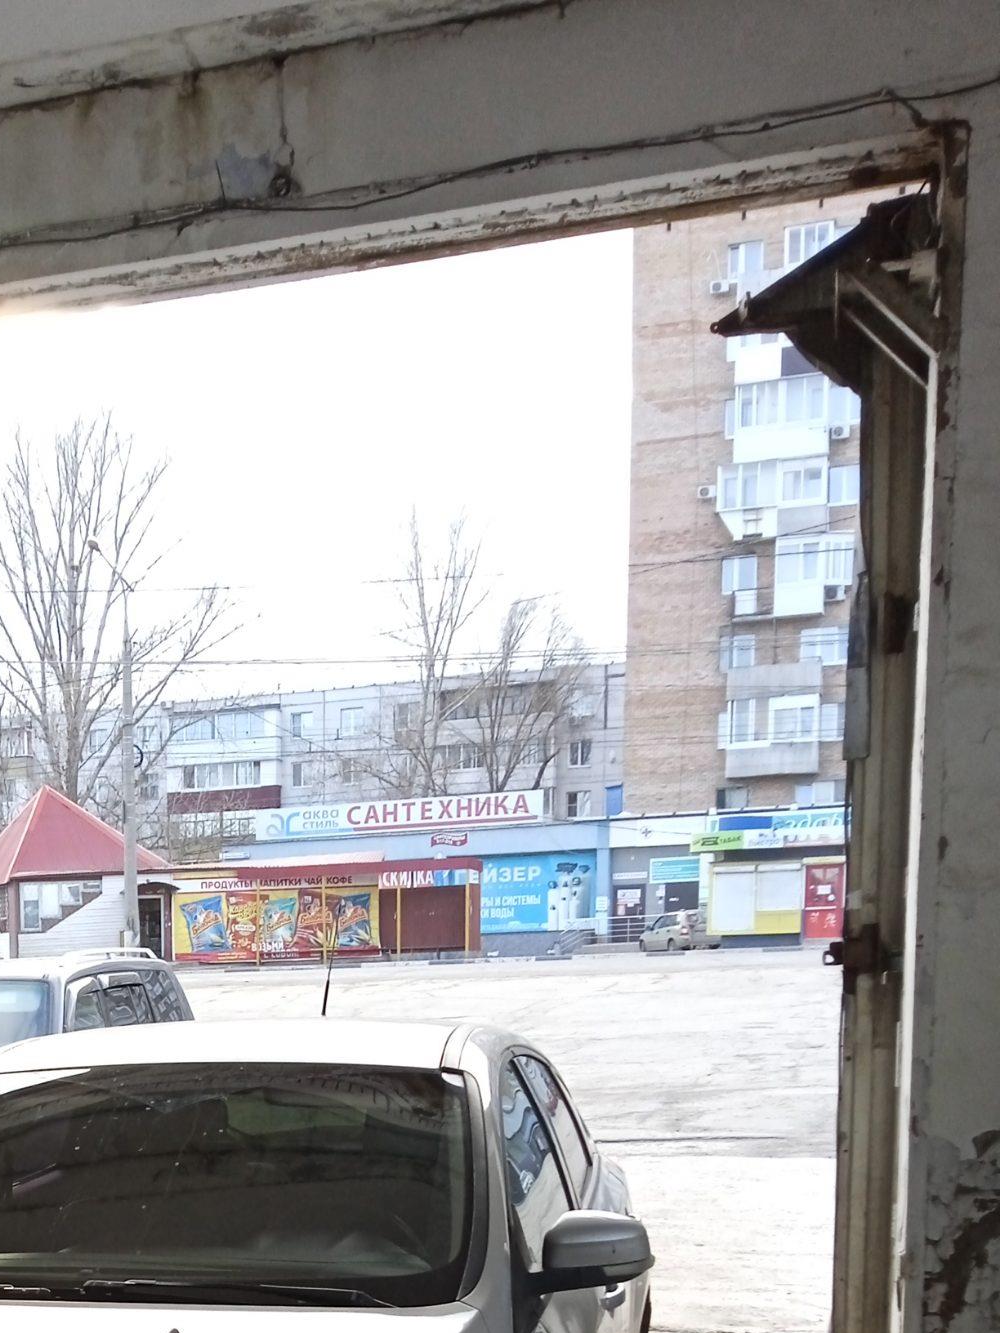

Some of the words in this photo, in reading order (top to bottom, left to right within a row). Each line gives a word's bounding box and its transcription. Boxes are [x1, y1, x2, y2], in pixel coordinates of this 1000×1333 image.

[346, 794, 530, 826] САНТЕХНИКА
[200, 880, 253, 891] ПРОДУКТЫ
[304, 875, 323, 886] ЧАЙ
[326, 875, 353, 886] КОФЕ
[502, 894, 541, 906] СИСТЕМЫ
[491, 907, 515, 919] ВОДЫ
